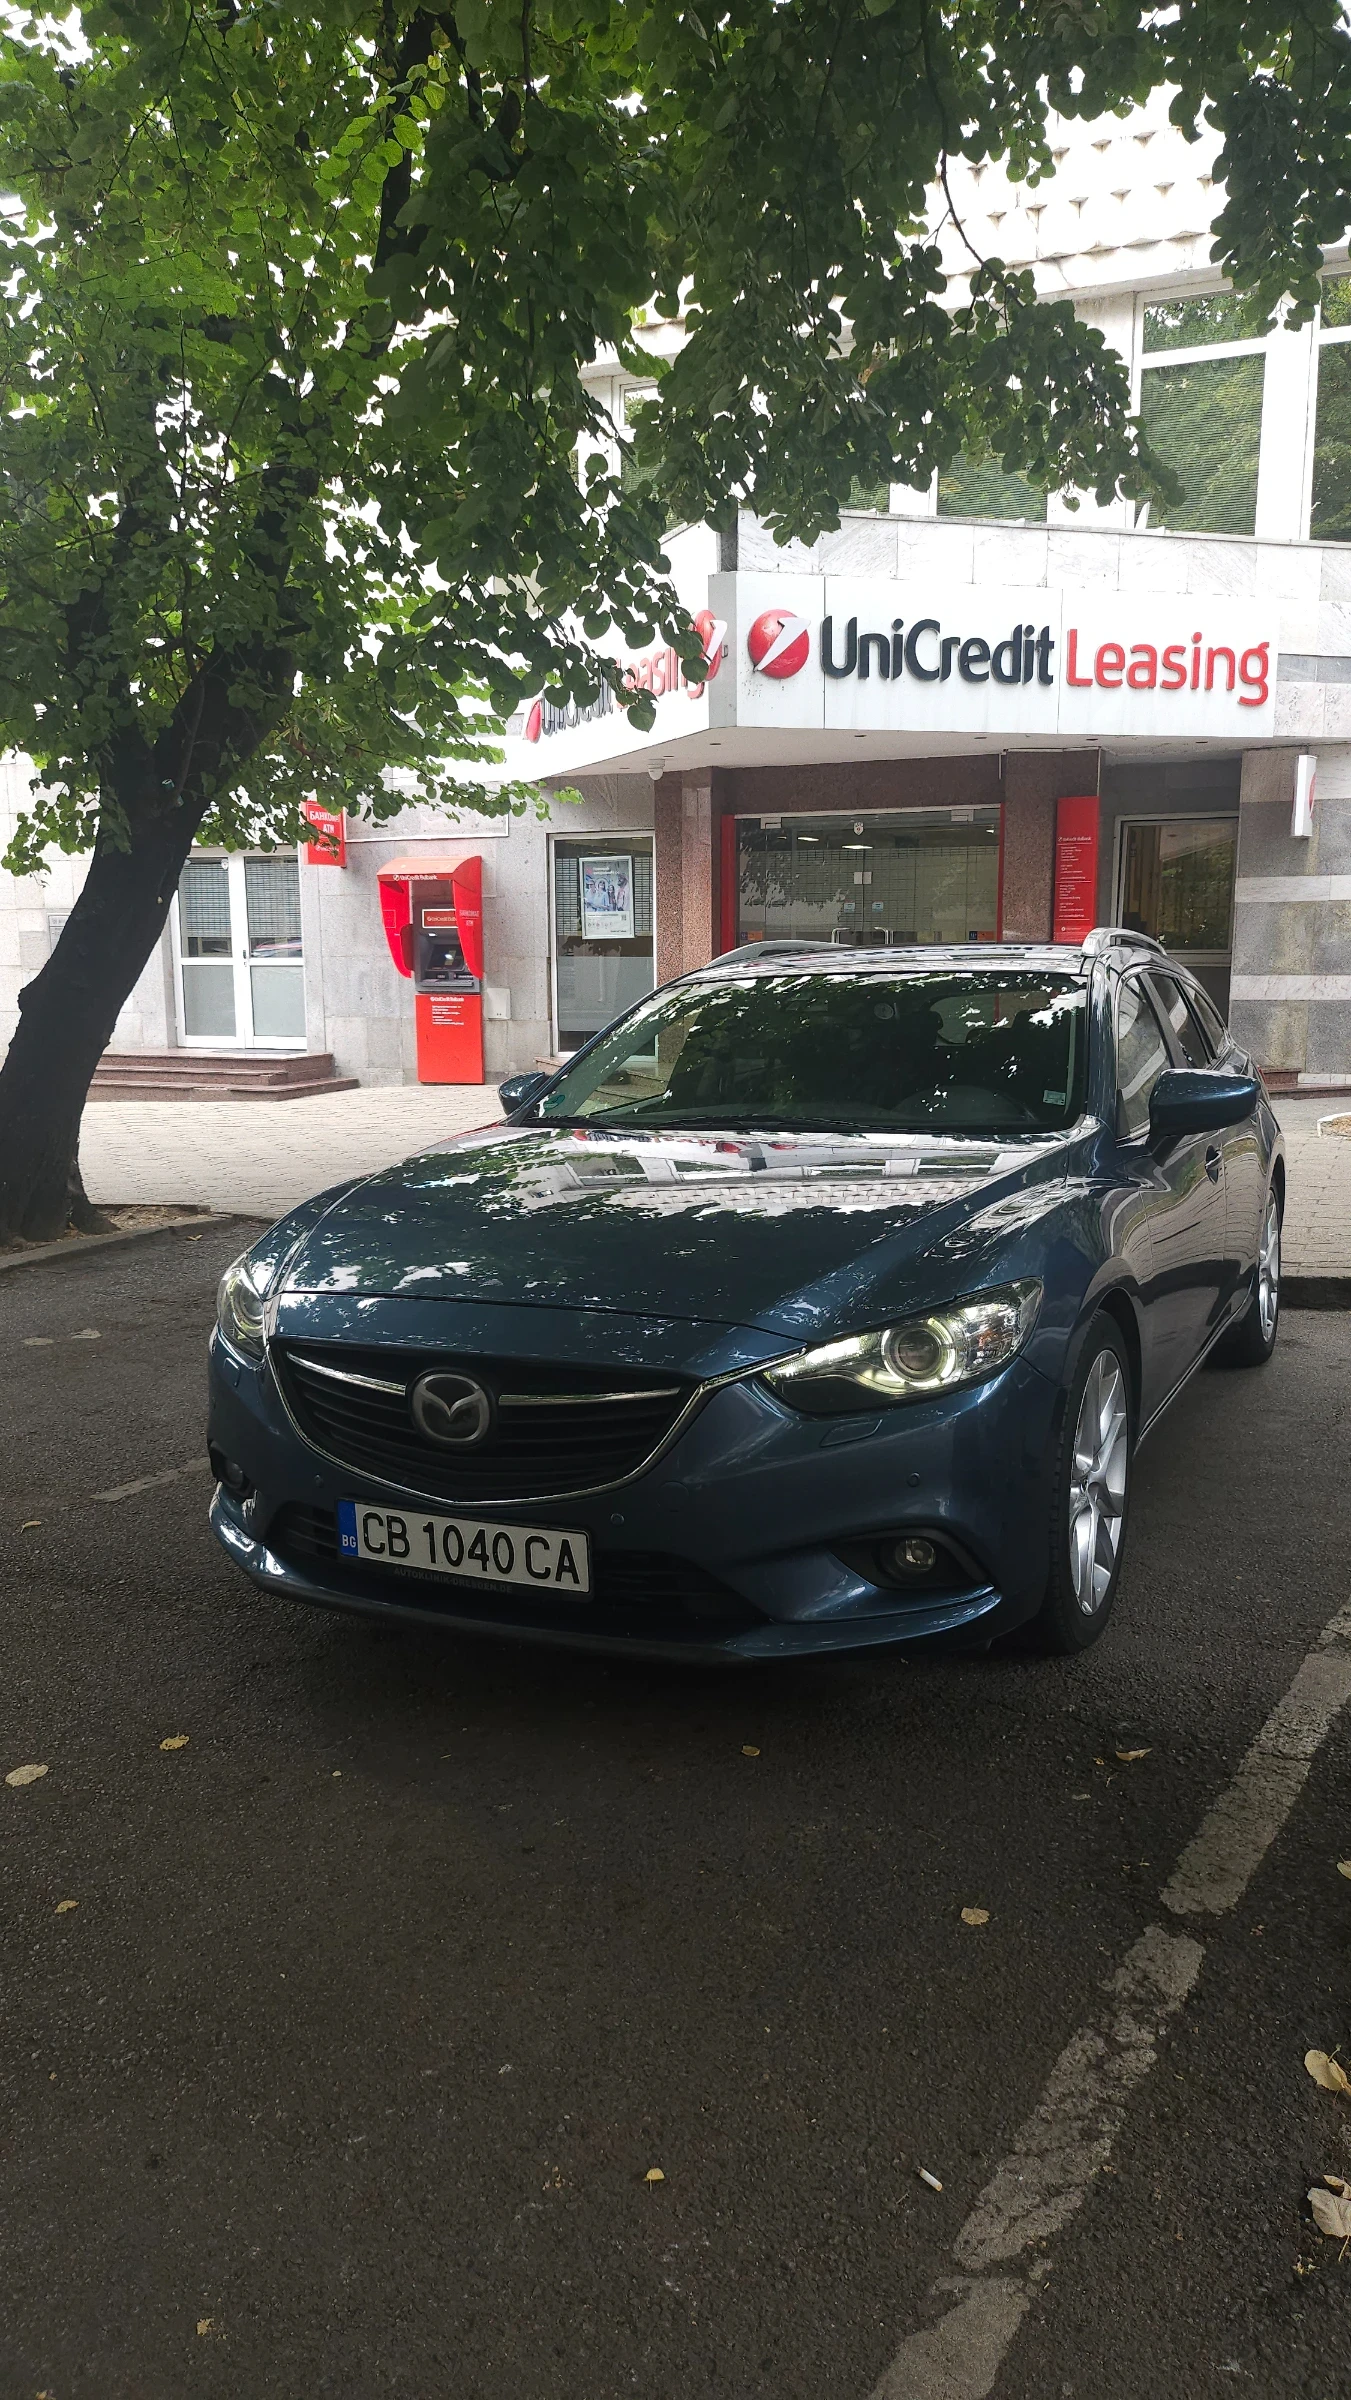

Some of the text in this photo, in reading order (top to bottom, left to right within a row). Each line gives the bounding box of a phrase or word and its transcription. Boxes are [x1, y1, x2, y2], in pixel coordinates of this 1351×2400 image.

[819, 615, 1270, 708] UniCredit Leasing
[342, 1534, 357, 1548] BG
[362, 1511, 581, 1585] CB 1040 CA
